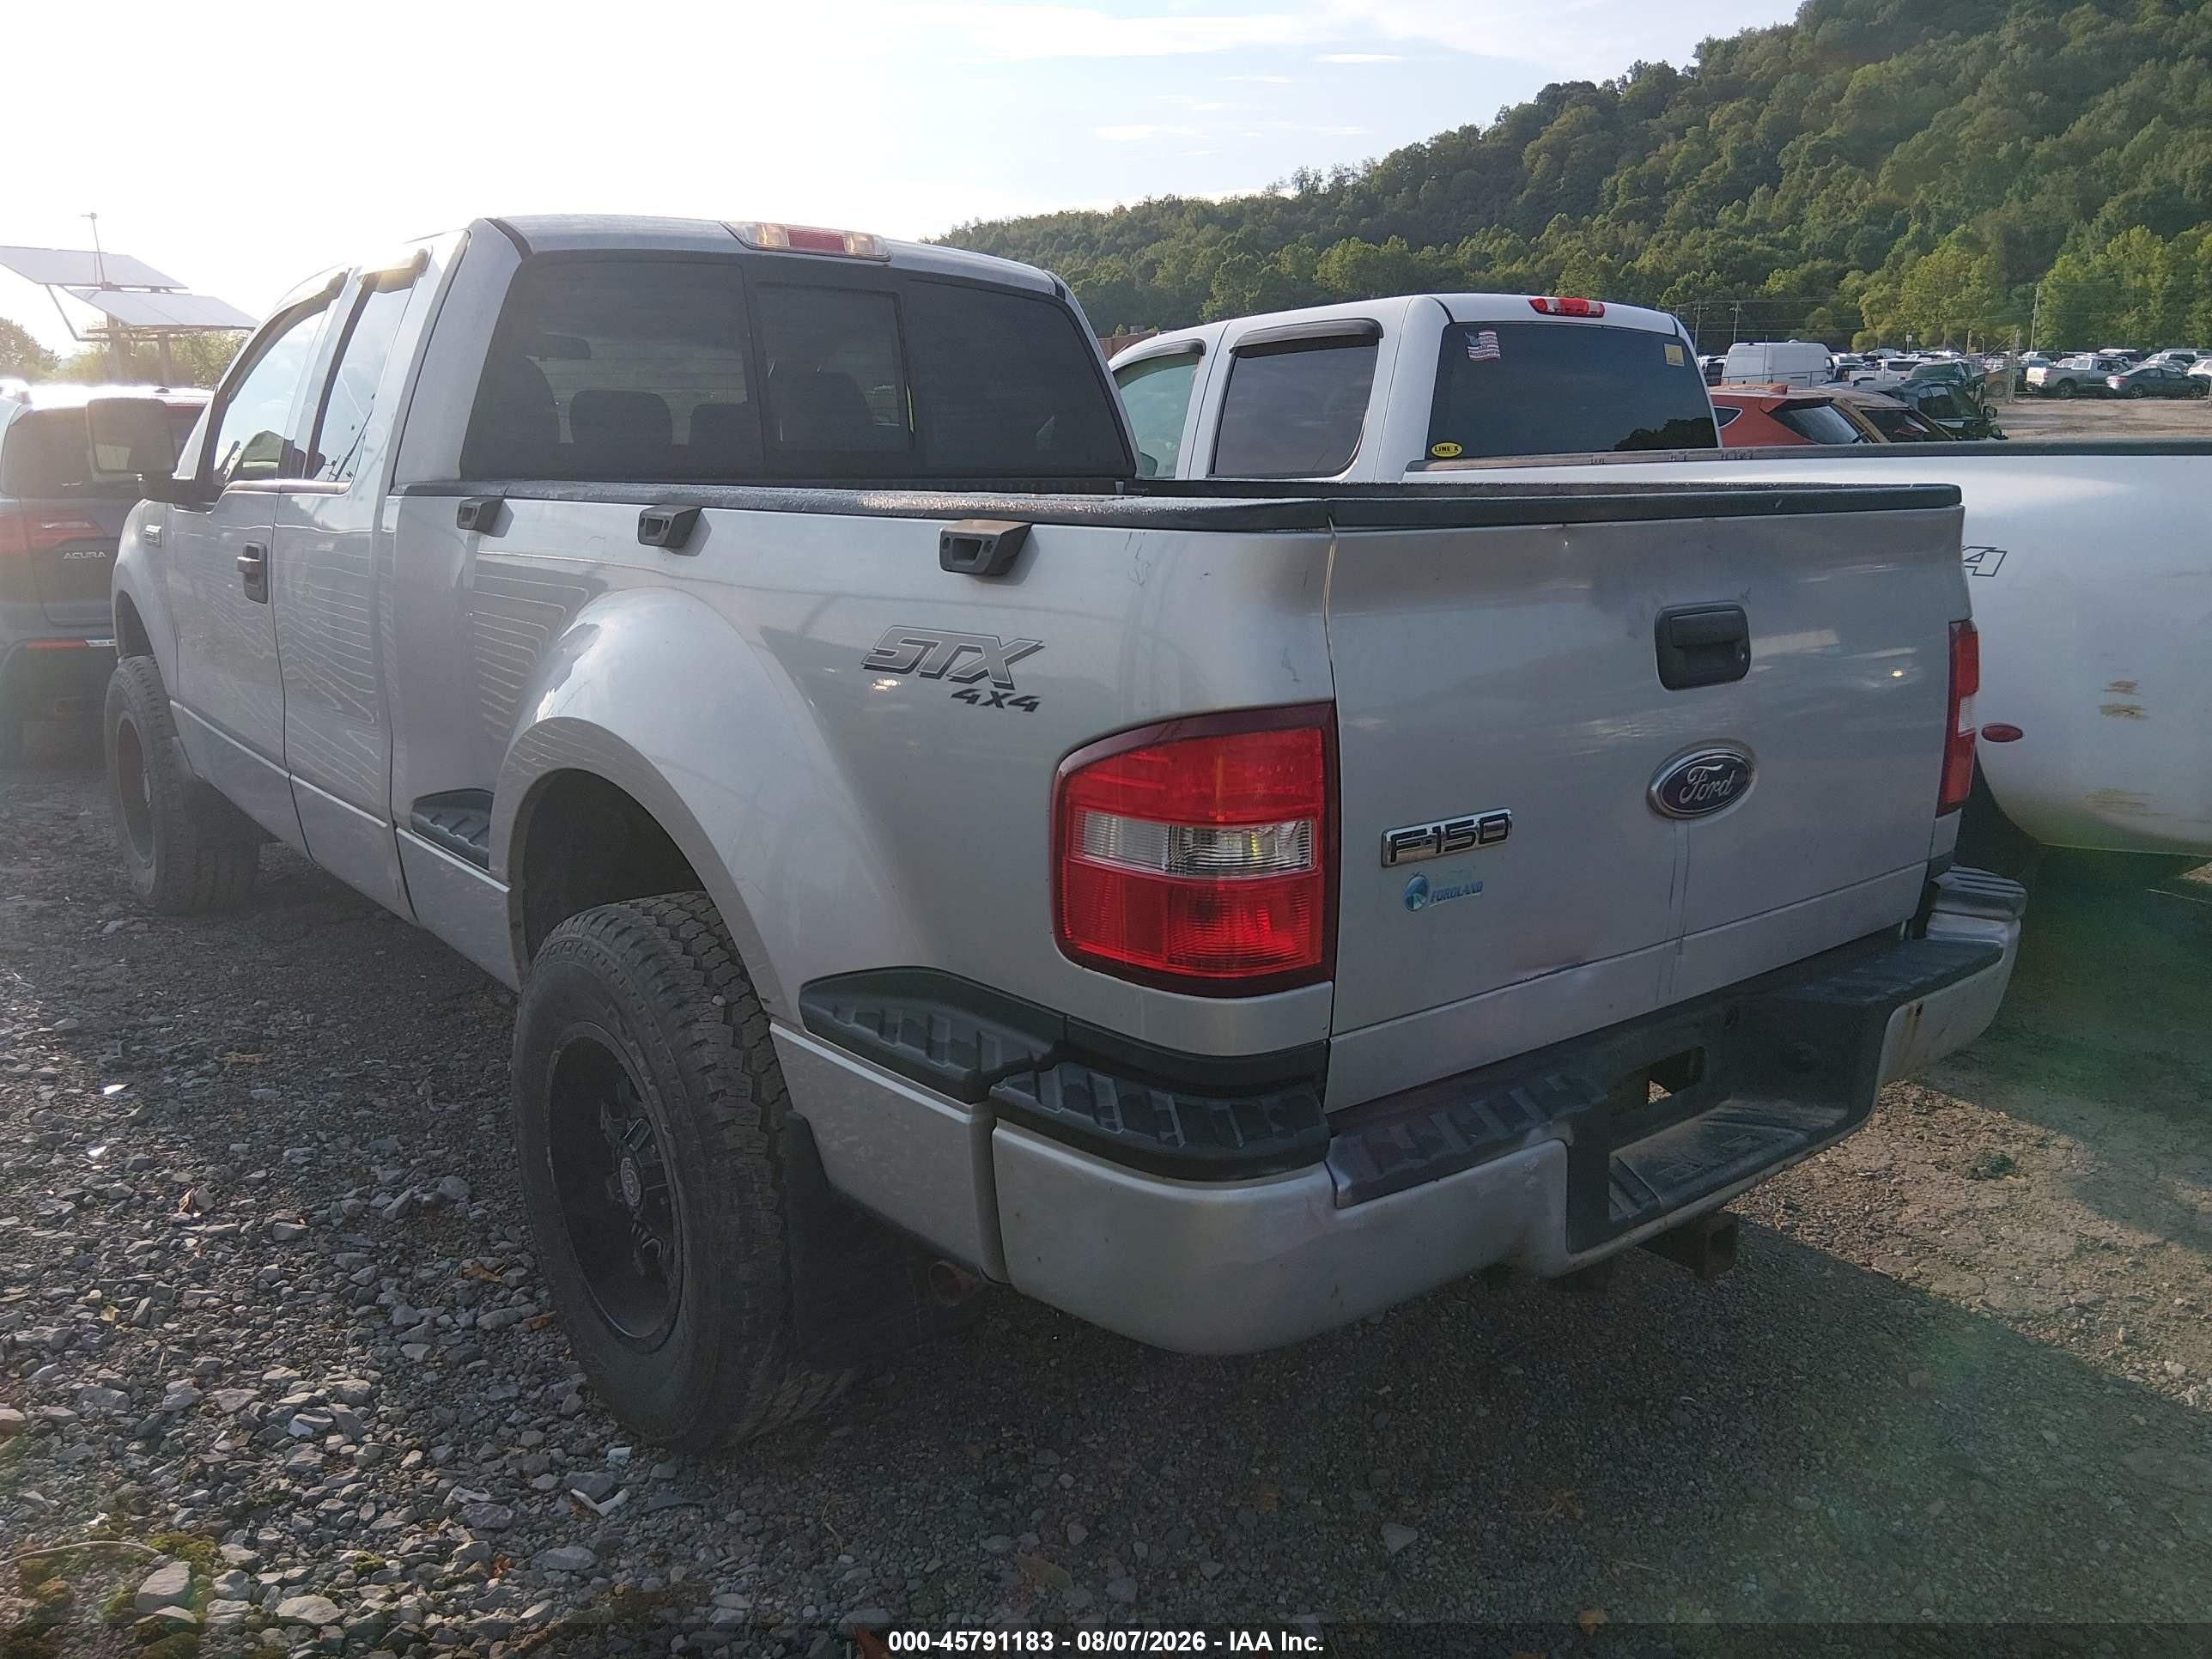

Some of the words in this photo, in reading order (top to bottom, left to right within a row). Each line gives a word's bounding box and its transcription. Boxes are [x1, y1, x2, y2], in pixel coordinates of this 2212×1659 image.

[64, 550, 107, 560] ACURA
[860, 624, 1046, 690] STX
[1679, 763, 1736, 804] Ford
[1389, 811, 1510, 864] F-150
